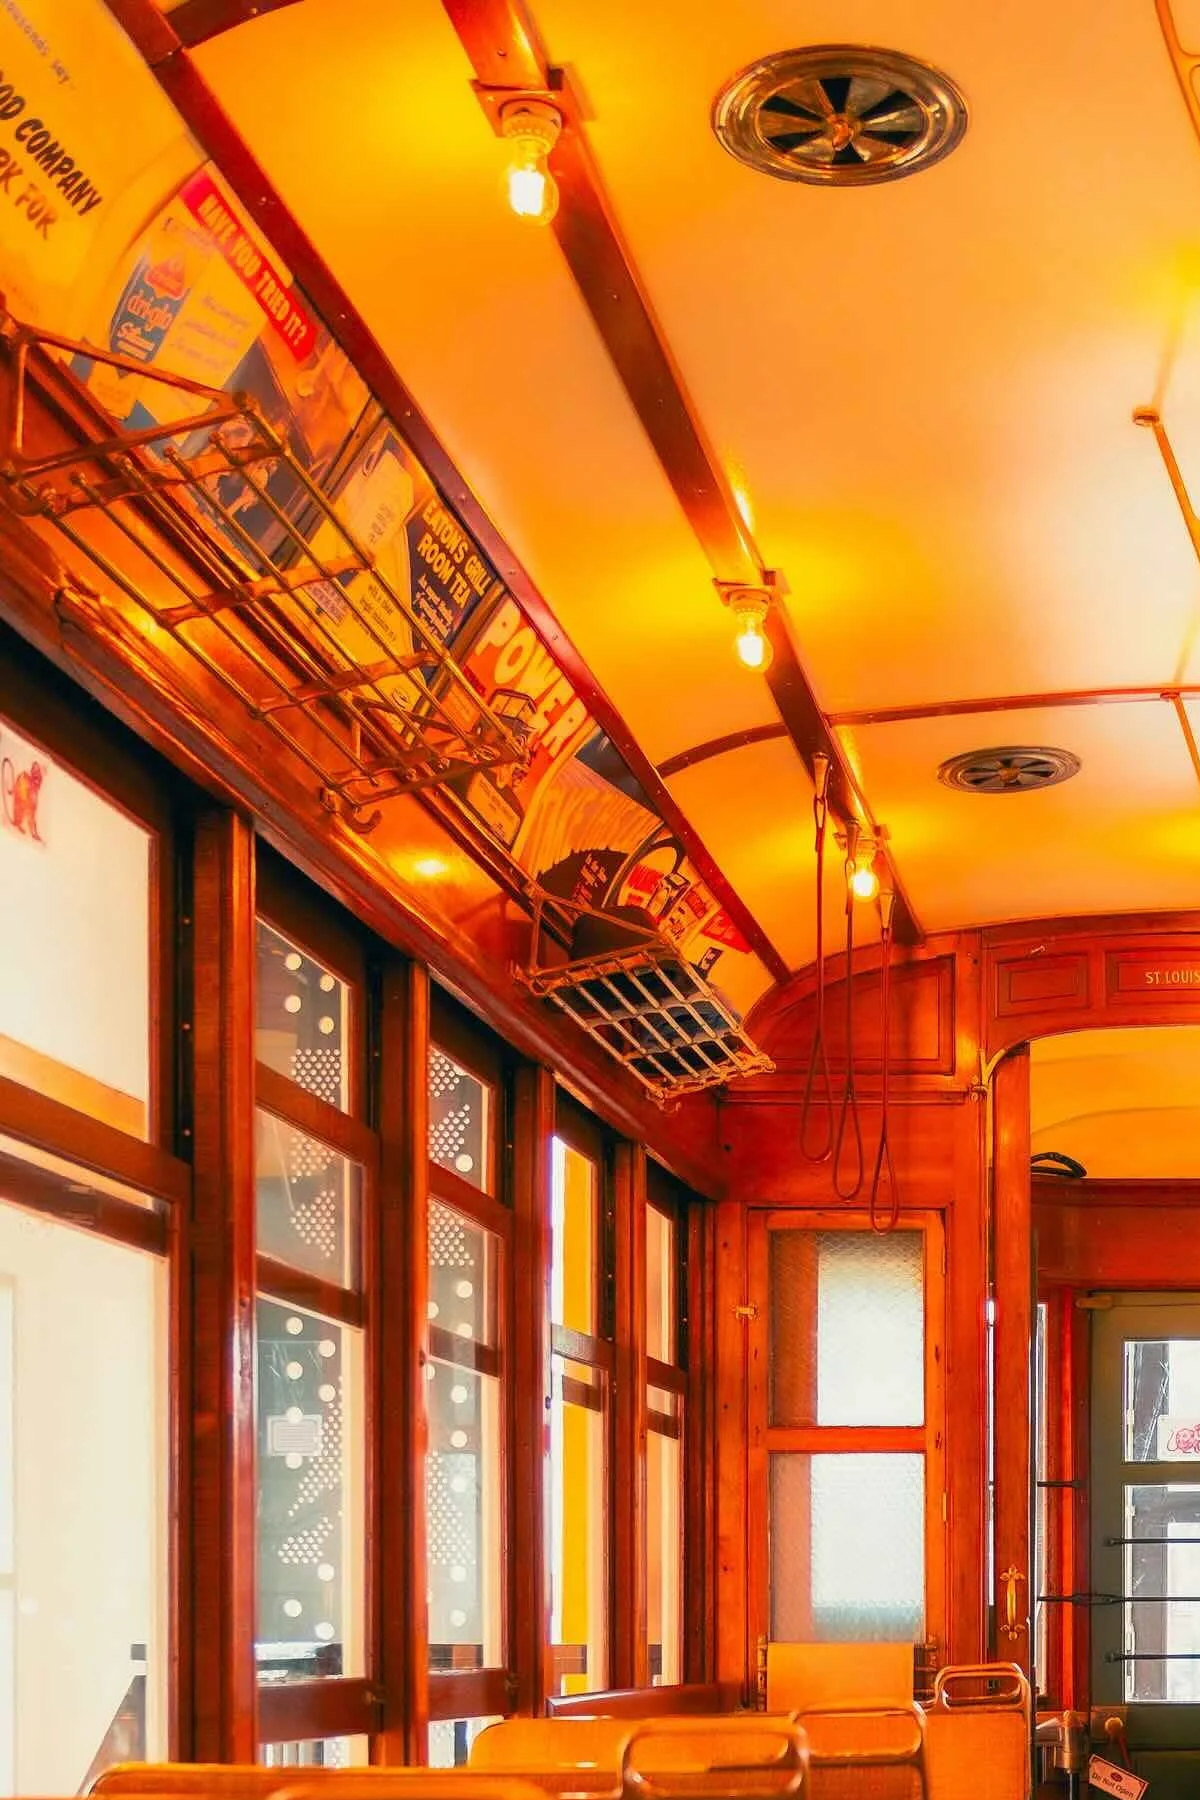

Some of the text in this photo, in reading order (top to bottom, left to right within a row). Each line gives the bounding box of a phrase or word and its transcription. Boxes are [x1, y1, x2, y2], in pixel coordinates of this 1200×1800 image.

[15, 118, 102, 216] COMPANY
[198, 194, 237, 243] HAVE
[230, 234, 262, 278] YOU
[255, 271, 291, 321] TRIED
[283, 315, 308, 346] IT?
[417, 533, 455, 585] ROOM
[449, 572, 471, 609] TEA
[464, 554, 492, 597] GRILL
[475, 596, 588, 758] POWER
